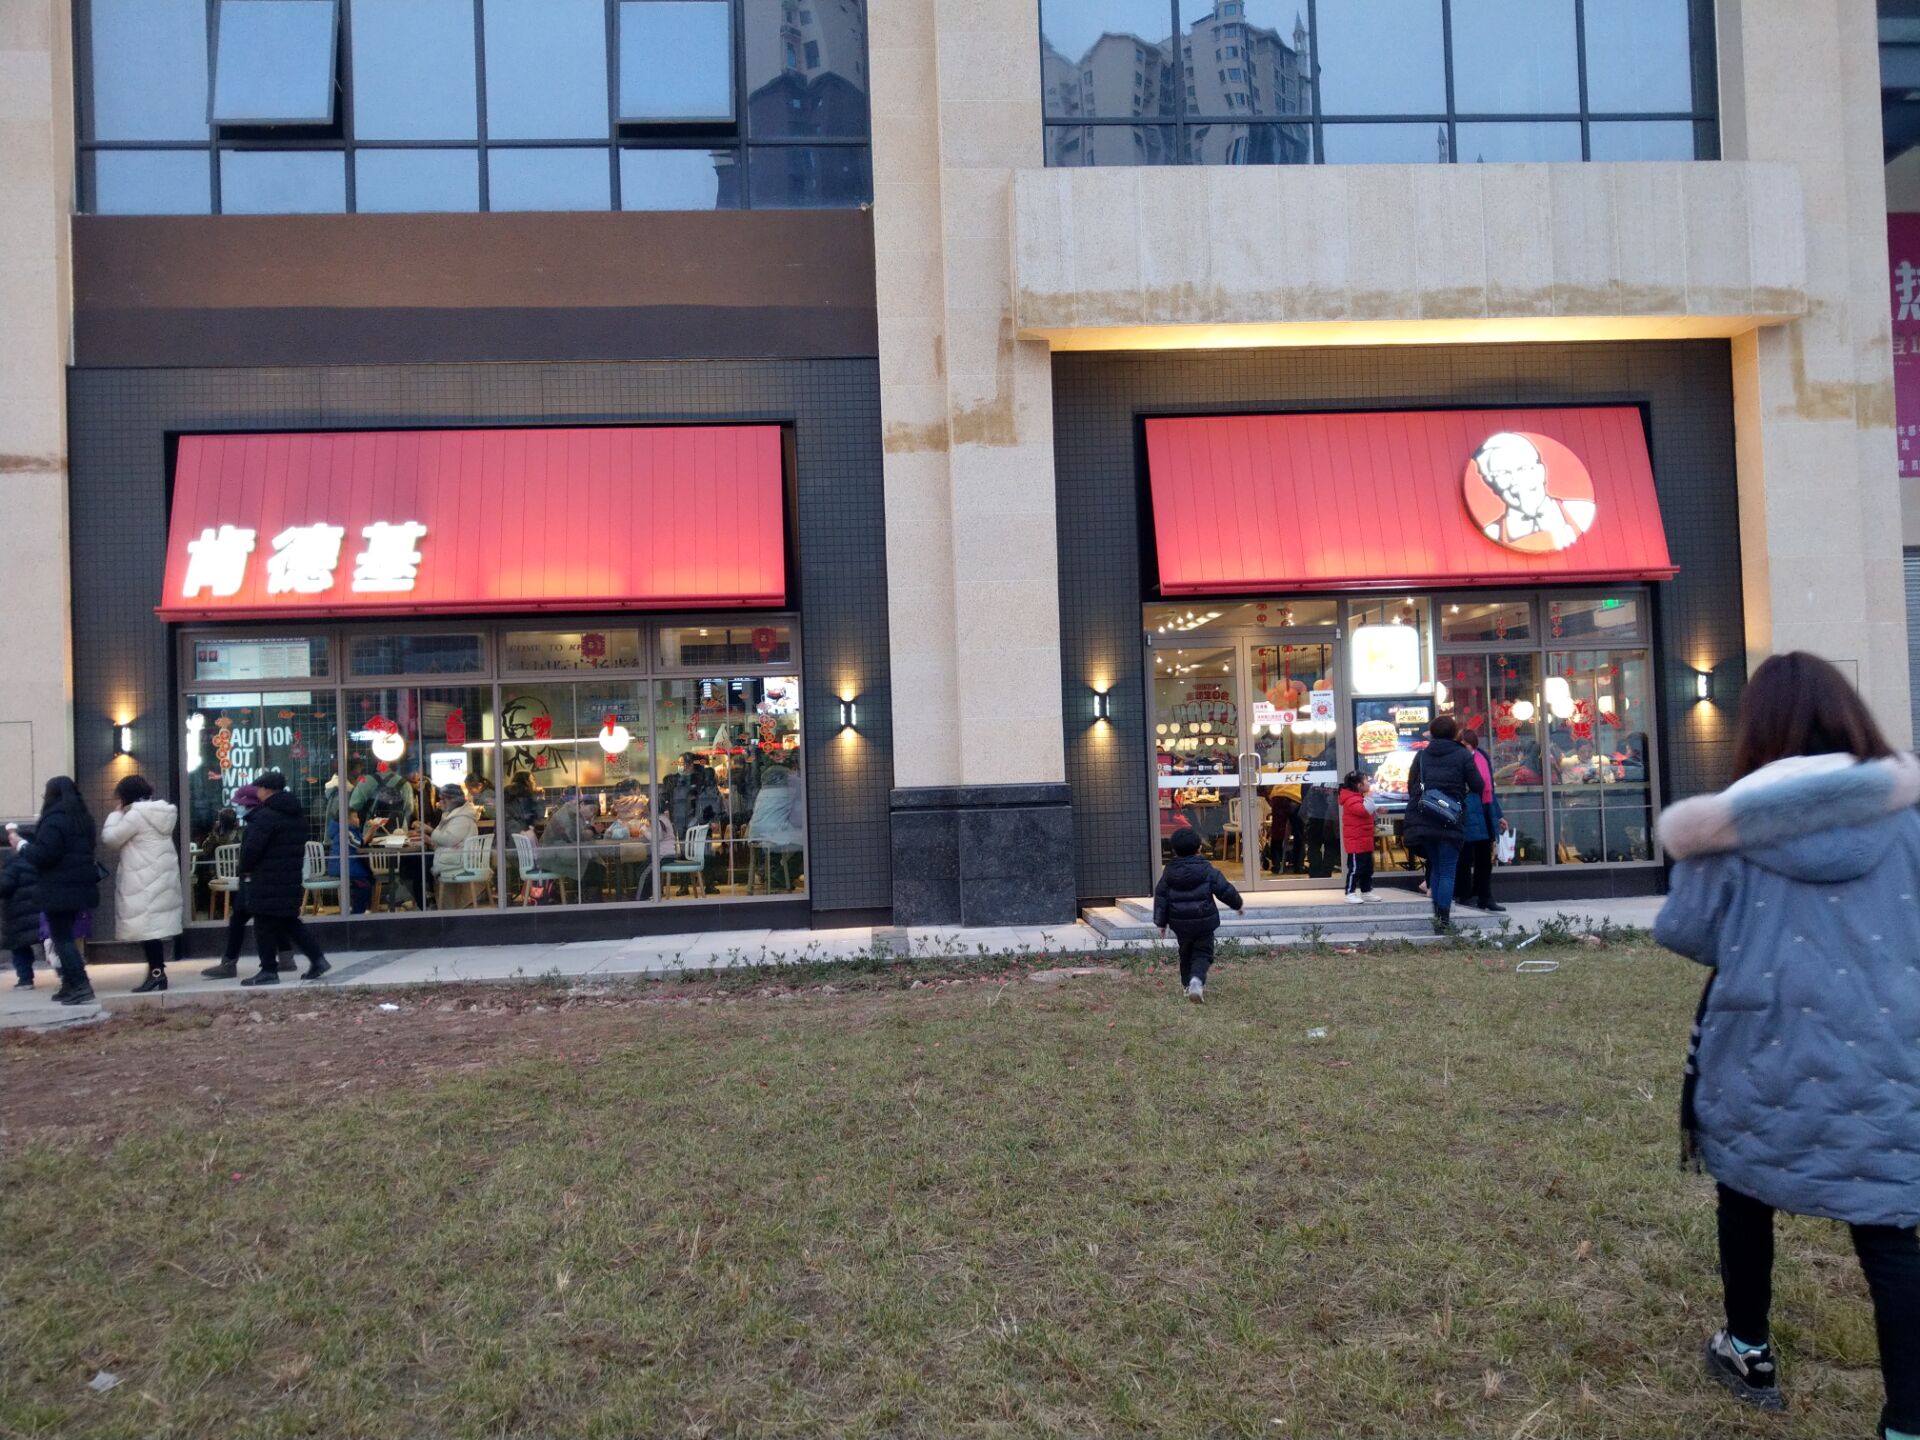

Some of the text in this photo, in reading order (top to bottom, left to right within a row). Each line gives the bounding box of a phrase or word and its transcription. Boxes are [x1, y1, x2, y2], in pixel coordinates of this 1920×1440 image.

[182, 521, 427, 597] 肯德基
[222, 726, 294, 748] AUTION
[223, 748, 254, 768] OT
[1186, 777, 1212, 786] KFC
[1285, 773, 1311, 782] KFC
